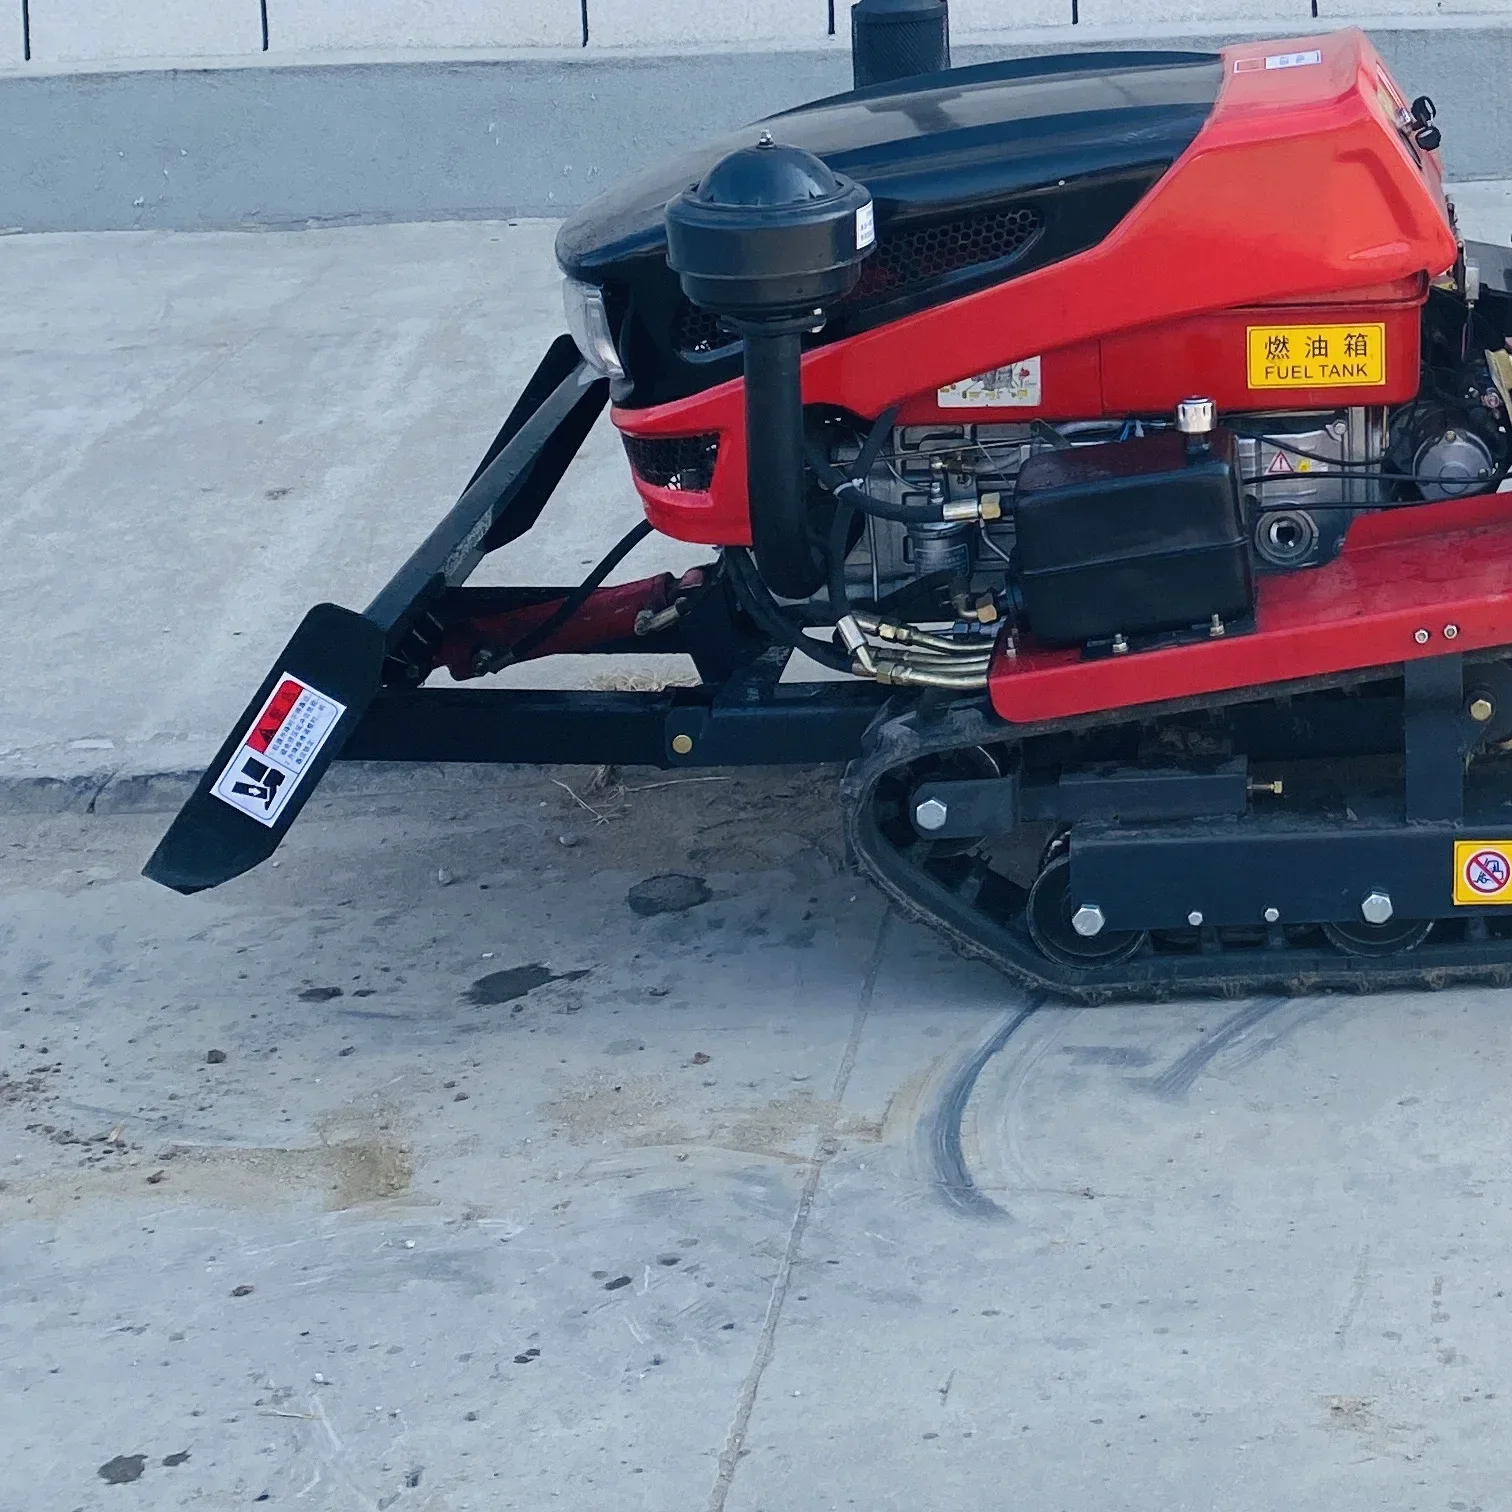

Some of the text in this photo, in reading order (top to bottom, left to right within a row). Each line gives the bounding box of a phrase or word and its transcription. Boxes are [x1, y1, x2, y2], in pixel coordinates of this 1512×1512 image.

[1264, 332, 1368, 360] 燃油箱
[1264, 362, 1368, 380] FUEL TANK
